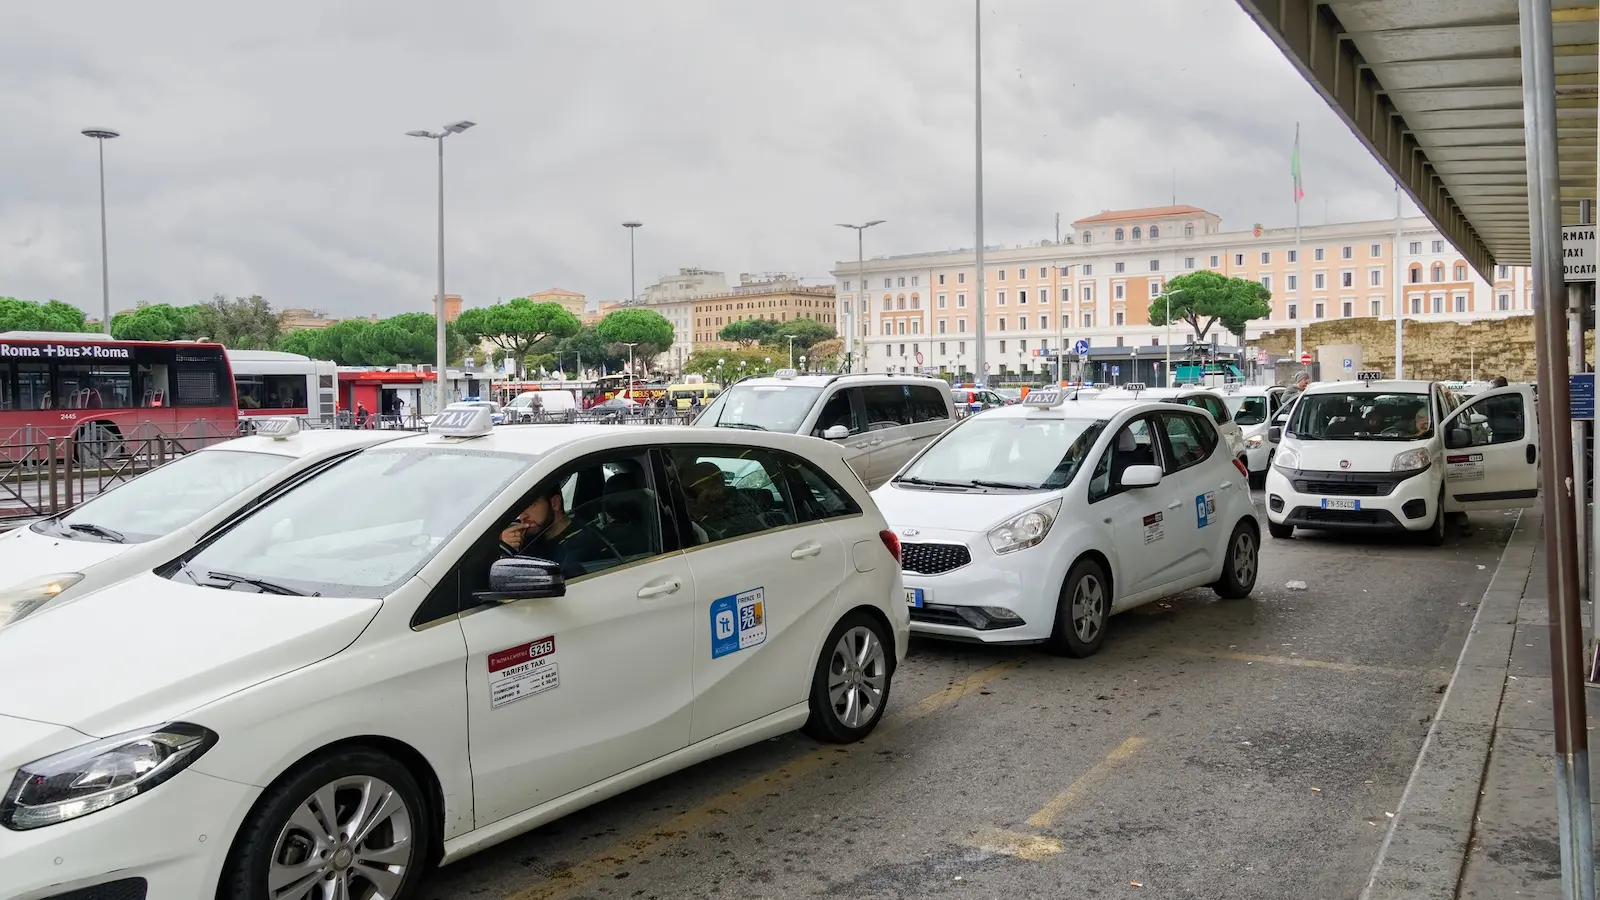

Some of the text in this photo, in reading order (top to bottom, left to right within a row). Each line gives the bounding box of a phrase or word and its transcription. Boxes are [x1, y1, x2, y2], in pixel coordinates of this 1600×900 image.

[1563, 248, 1583, 258] TAXI
[1, 344, 40, 357] Roma
[1359, 372, 1380, 380] TAXI
[1028, 393, 1056, 403] TAXI
[435, 411, 475, 426] TAXI
[260, 420, 287, 431] TAXI
[906, 592, 915, 603] AE
[742, 606, 754, 620] 35
[531, 642, 551, 657] 5215
[502, 663, 529, 678] TARIFFE
[530, 658, 546, 668] TAXI
